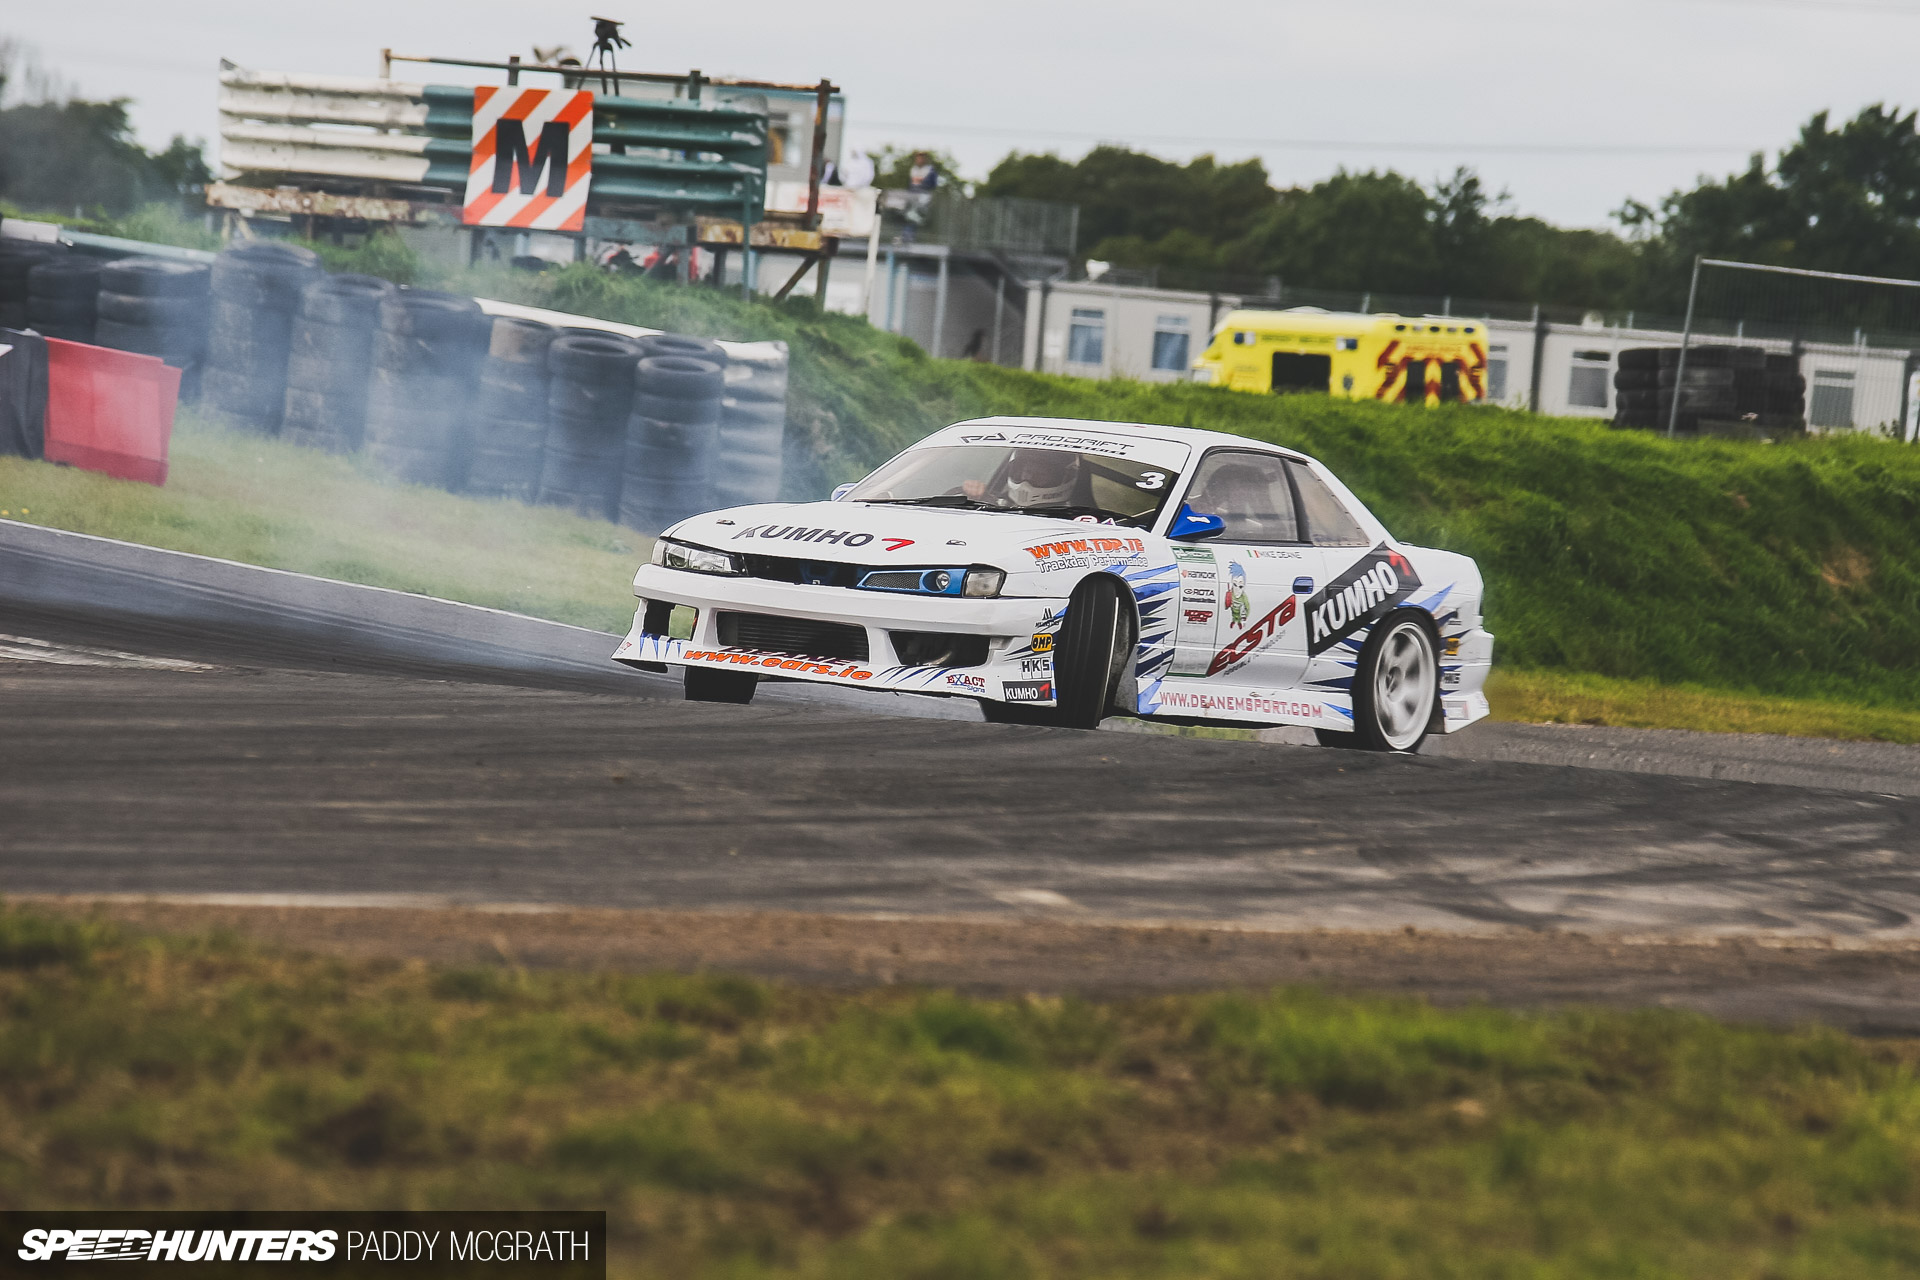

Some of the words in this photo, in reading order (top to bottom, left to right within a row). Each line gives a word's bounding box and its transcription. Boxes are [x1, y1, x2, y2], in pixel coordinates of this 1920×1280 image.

[492, 119, 569, 197] M
[1014, 433, 1134, 450] PRODRIFT
[1135, 471, 1166, 490] 3
[731, 524, 875, 547] KUMHO
[1023, 538, 1146, 560] WWW.TDP.IE
[1035, 555, 1090, 574] Trackday
[1091, 553, 1149, 568] Performance
[1311, 561, 1399, 644] KUMHO
[1032, 636, 1052, 649] OMP
[683, 650, 874, 681] www.ears.ie
[1021, 658, 1051, 673] HKS
[946, 673, 985, 688] EXACT
[1005, 686, 1039, 700] KUMHO
[1159, 691, 1323, 719] WWW.DEANEMSPORT.COM
